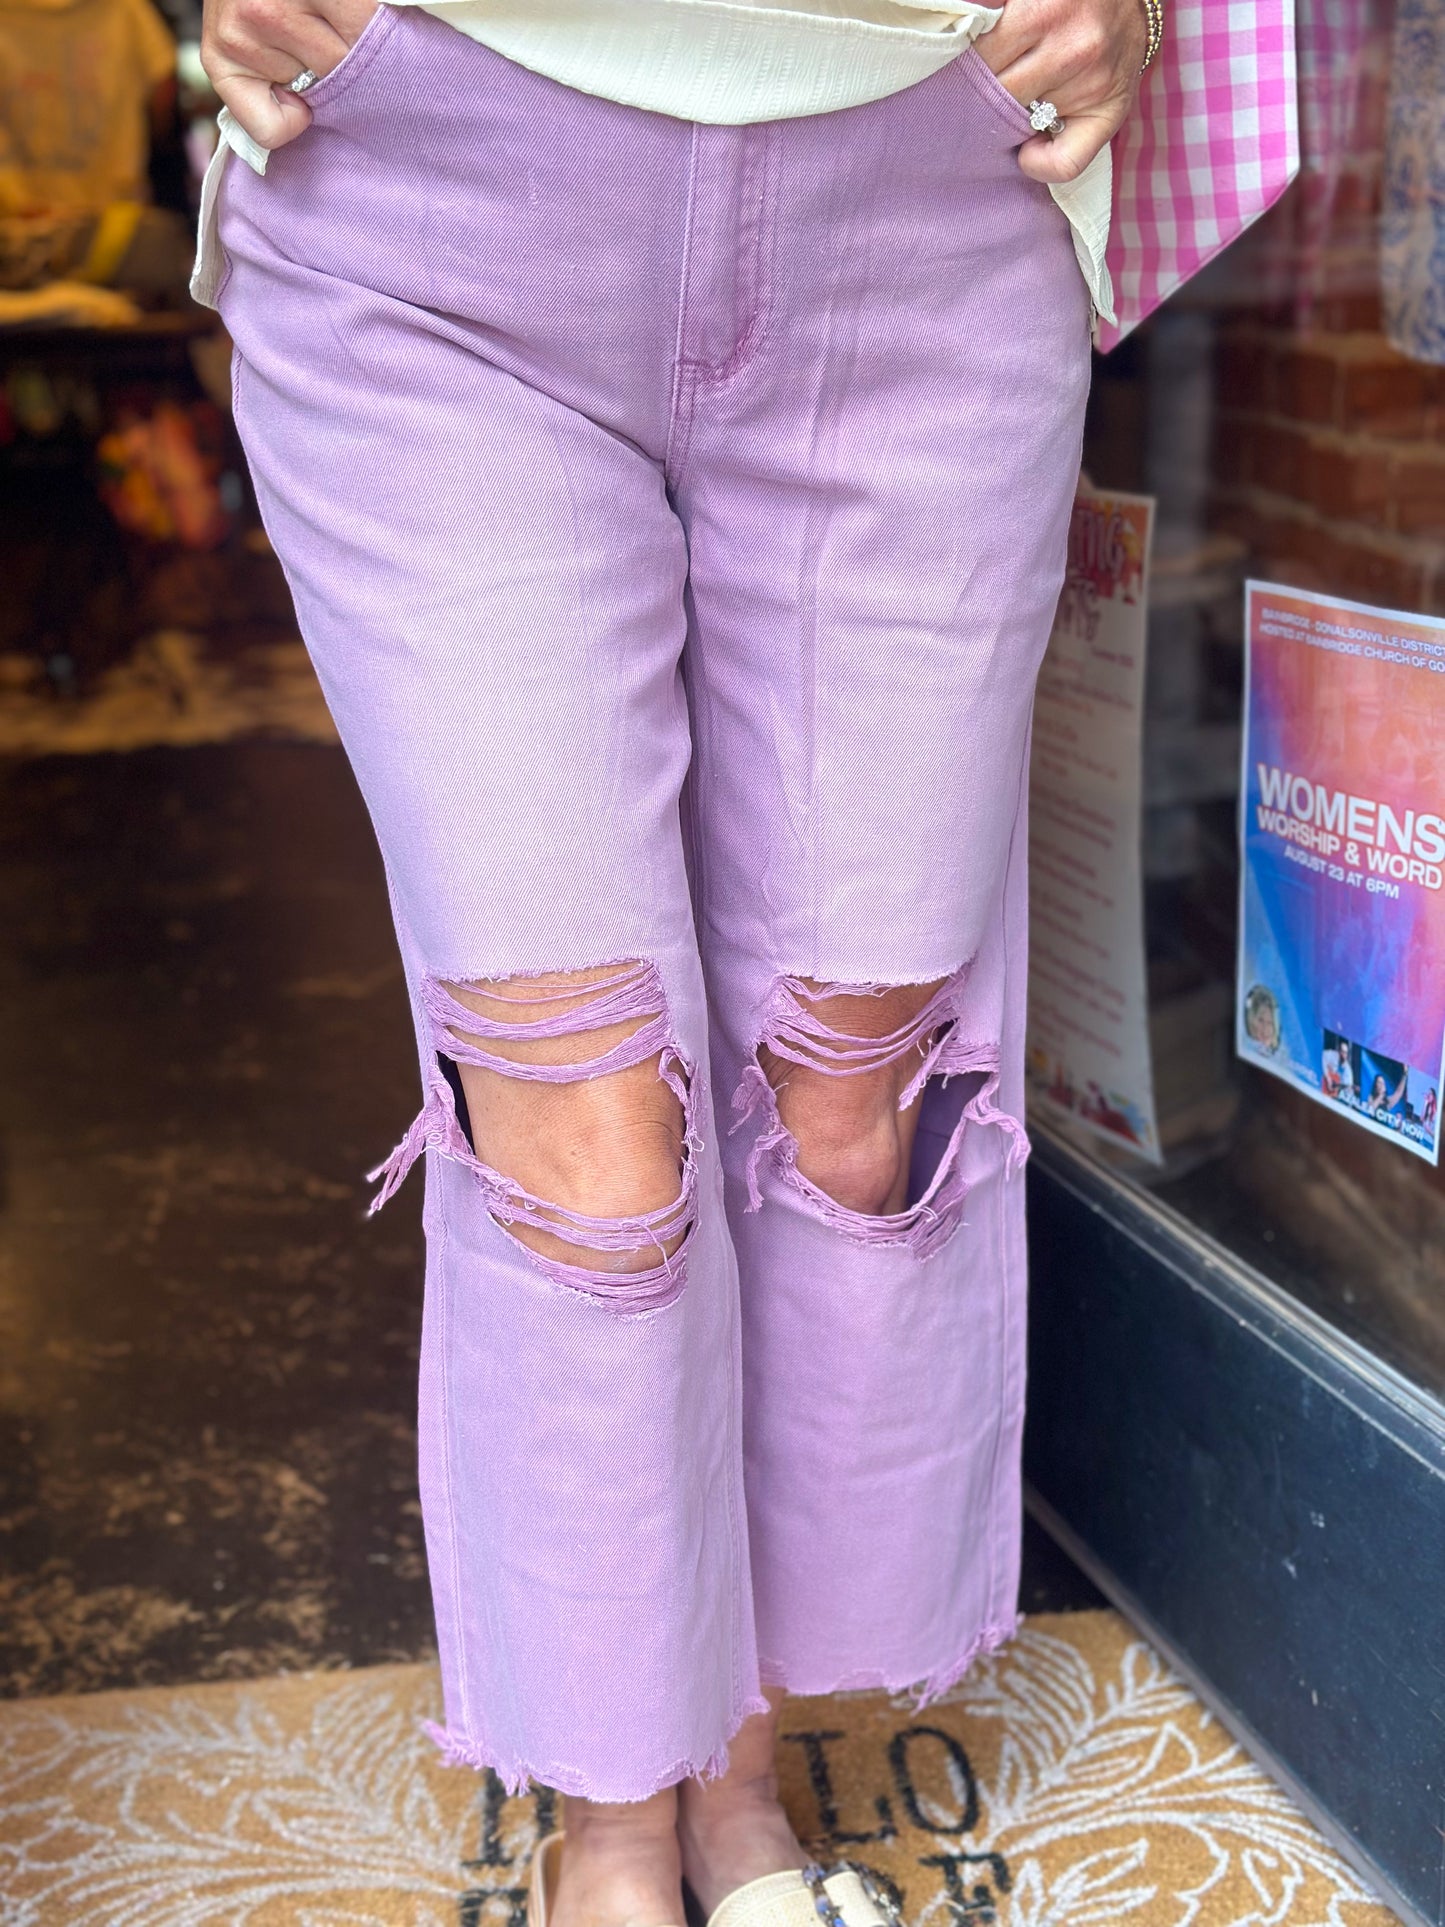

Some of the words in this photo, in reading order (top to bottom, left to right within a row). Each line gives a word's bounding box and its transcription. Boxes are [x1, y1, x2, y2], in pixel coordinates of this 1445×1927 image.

[1364, 646, 1410, 665] CHURCH
[1412, 655, 1427, 669] OF
[1428, 659, 1445, 673] GO
[1257, 763, 1445, 863] WOMENS
[1257, 805, 1340, 856] WORSHIP
[1344, 841, 1361, 867] &
[1366, 846, 1443, 890] WORD
[1284, 844, 1327, 874] AUGUST
[1346, 871, 1364, 888] AT
[1365, 877, 1400, 900] 6PM
